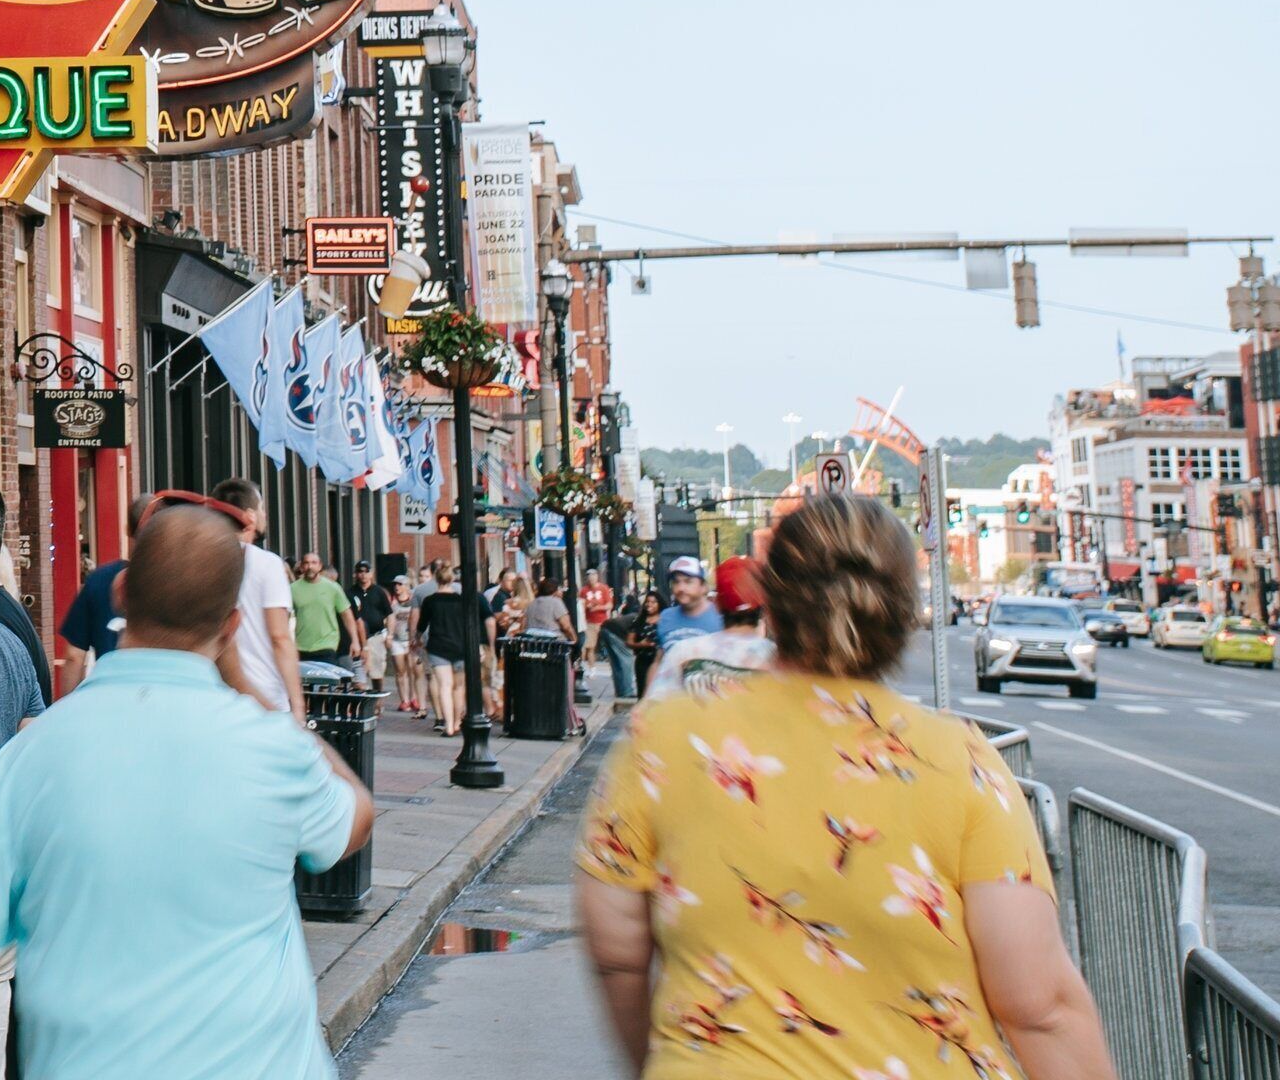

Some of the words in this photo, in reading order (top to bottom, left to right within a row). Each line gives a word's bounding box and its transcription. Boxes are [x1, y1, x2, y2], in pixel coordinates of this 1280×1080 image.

[362, 16, 398, 40] DIERKS
[389, 59, 428, 257] WHISKEY
[474, 173, 524, 186] PRIDE
[475, 188, 524, 198] PARADE
[476, 220, 507, 230] JUNE
[511, 220, 524, 228] 22
[314, 229, 386, 243] BAILEY'S
[485, 234, 516, 244] 10AM
[478, 247, 527, 256] BROADWAY
[55, 407, 105, 424] STAGE
[405, 507, 428, 516] WAY
